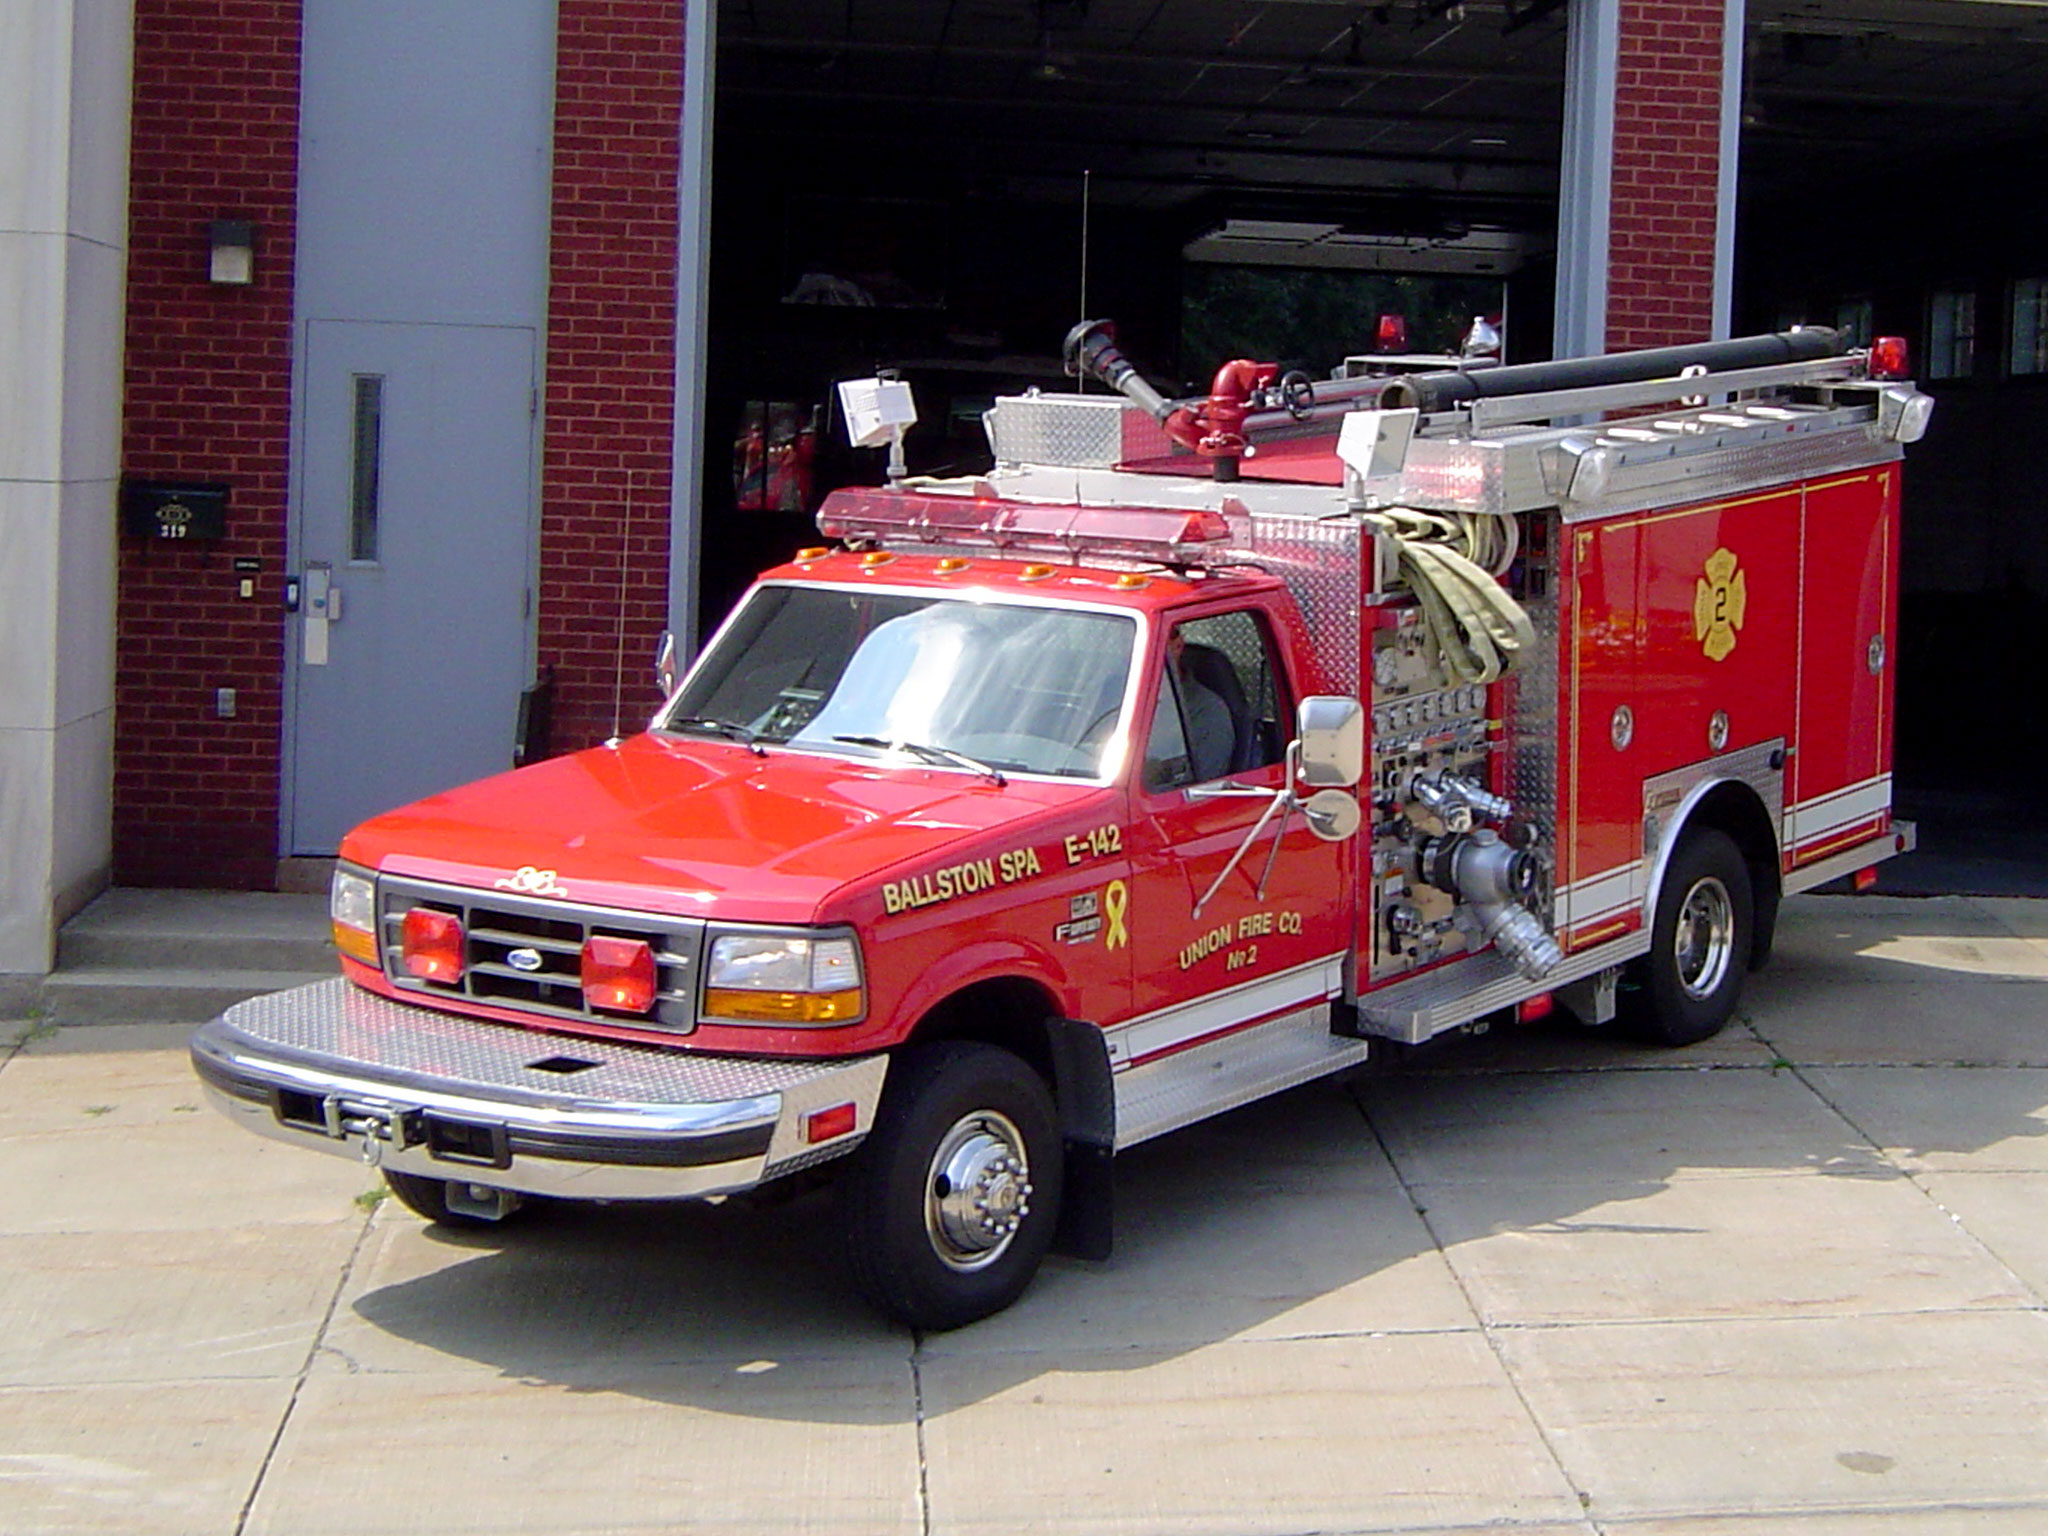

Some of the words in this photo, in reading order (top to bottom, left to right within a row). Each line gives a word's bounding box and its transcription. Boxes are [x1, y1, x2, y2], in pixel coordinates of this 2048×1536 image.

[1715, 587, 1727, 622] 2
[882, 858, 995, 914] BALLSTON
[1000, 847, 1041, 883] SPA
[1064, 823, 1123, 865] E-142
[1179, 923, 1232, 970] UNION
[1238, 912, 1273, 939] FIRE
